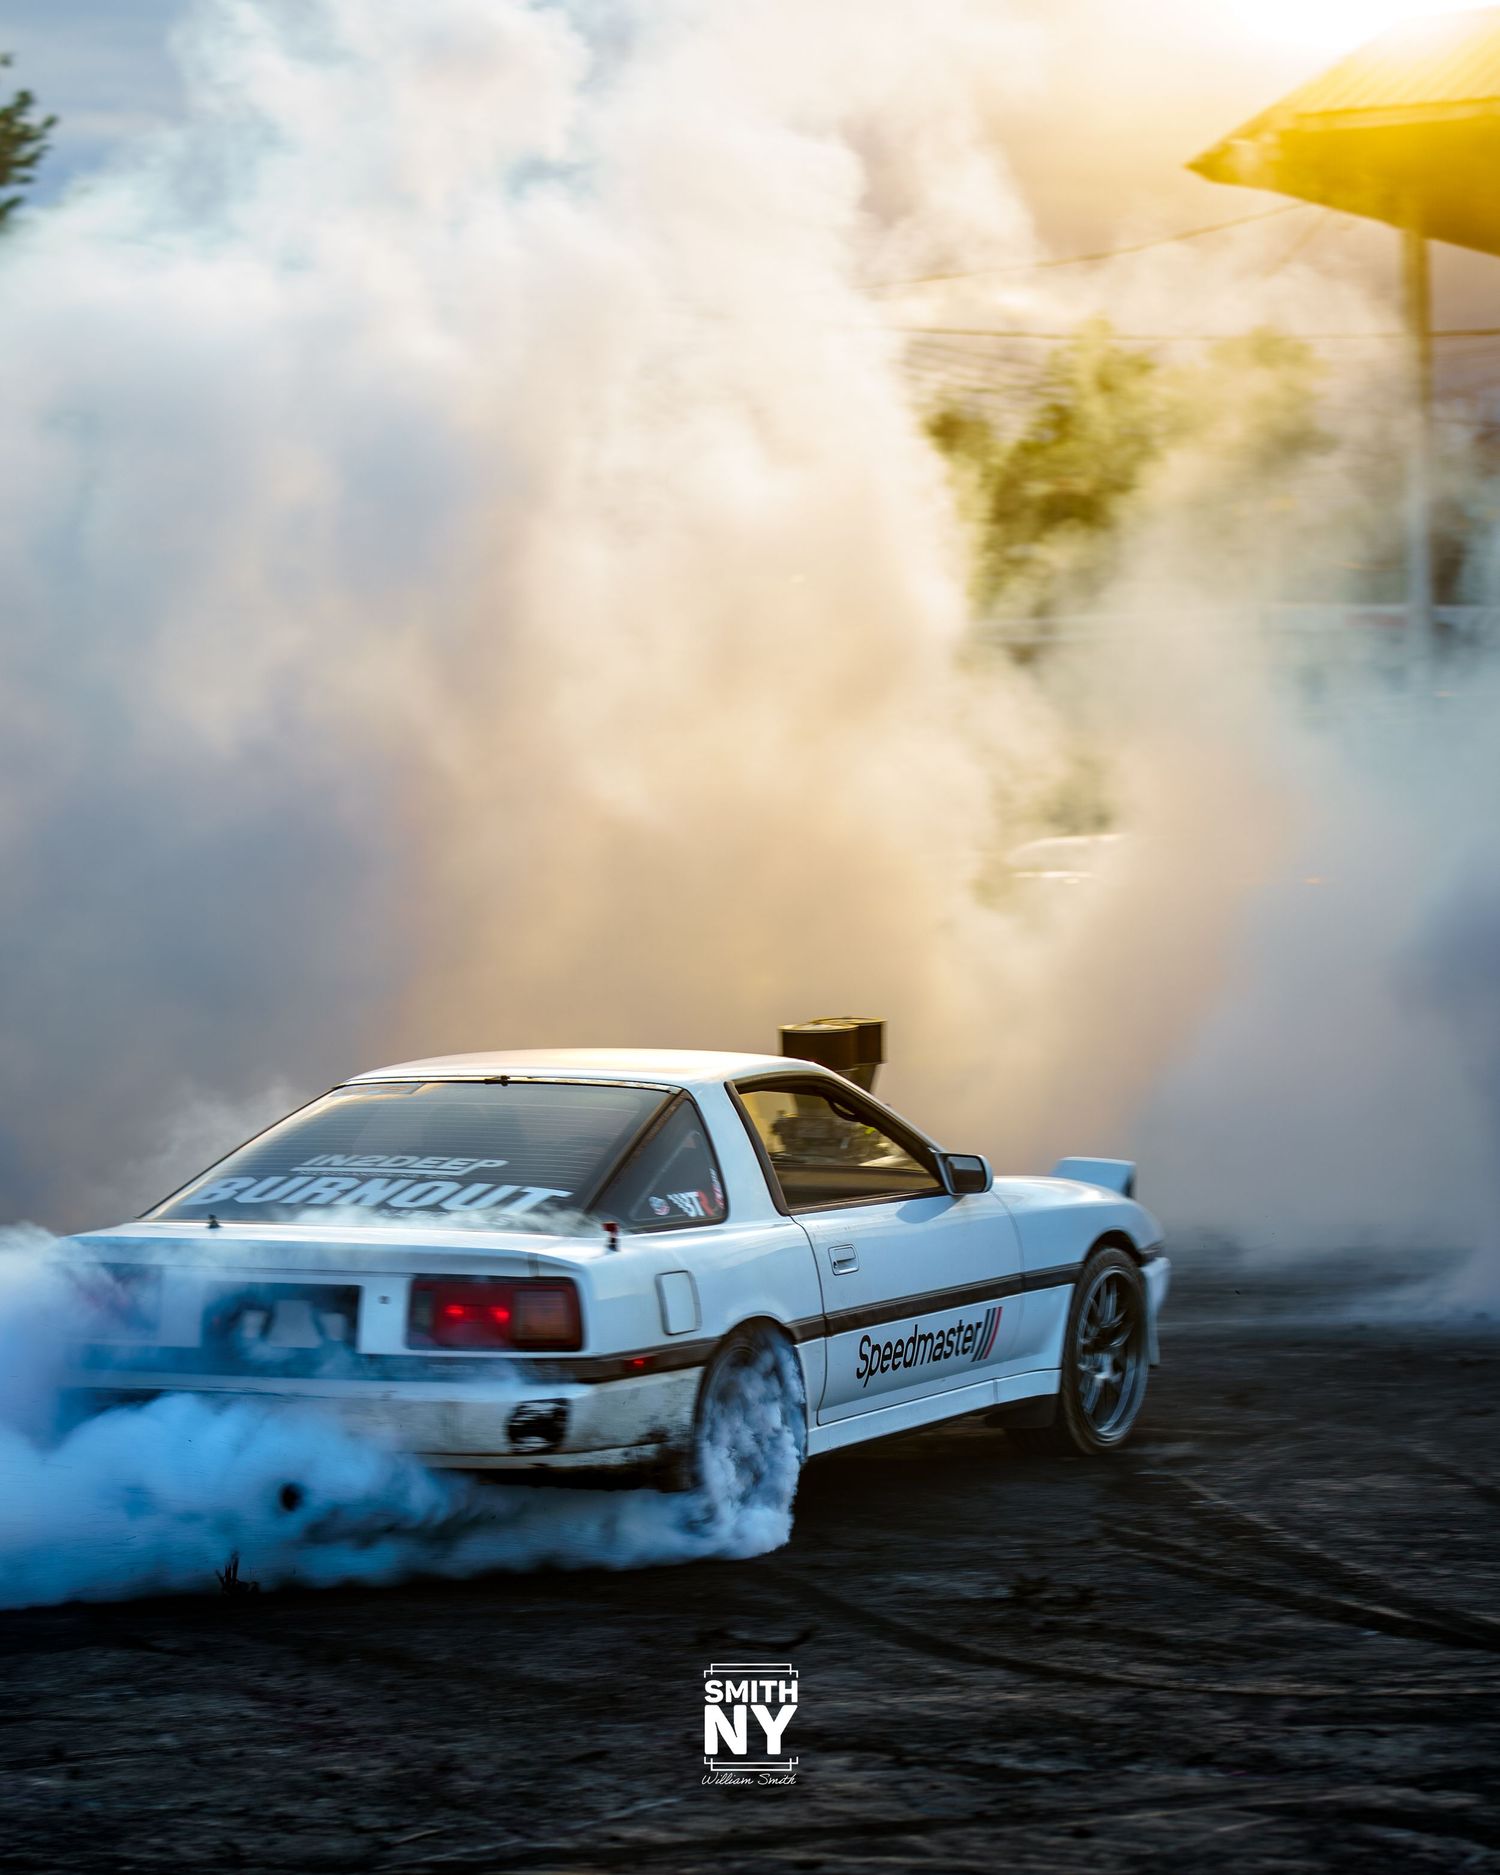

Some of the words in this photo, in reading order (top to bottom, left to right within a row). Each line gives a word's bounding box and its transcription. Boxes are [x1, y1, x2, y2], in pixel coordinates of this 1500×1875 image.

[298, 1154, 509, 1176] IN2DEEP
[181, 1176, 573, 1215] BURNOUT
[856, 1319, 983, 1388] Speedmaster
